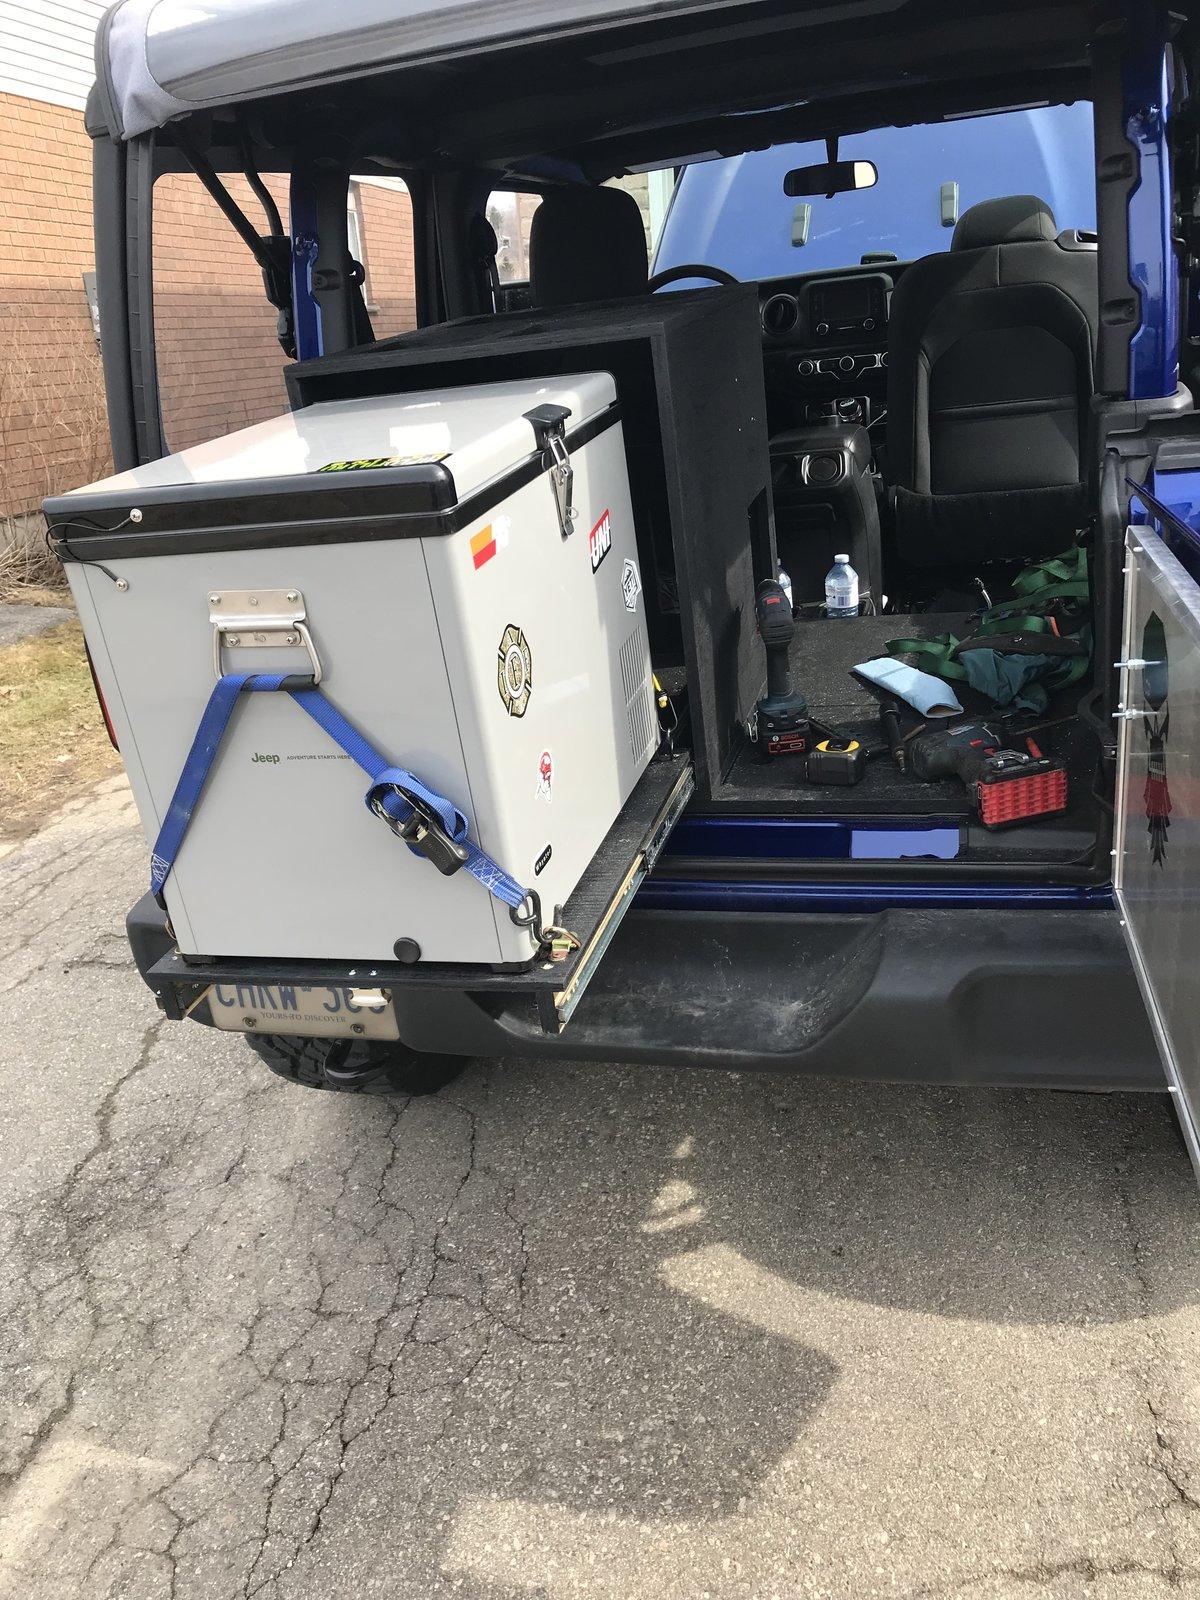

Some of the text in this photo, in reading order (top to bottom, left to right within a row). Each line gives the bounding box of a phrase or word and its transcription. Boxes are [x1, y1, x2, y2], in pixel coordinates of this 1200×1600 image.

[251, 752, 281, 765] Jeep
[260, 1011, 347, 1023] YOURS TO DISCOVER
